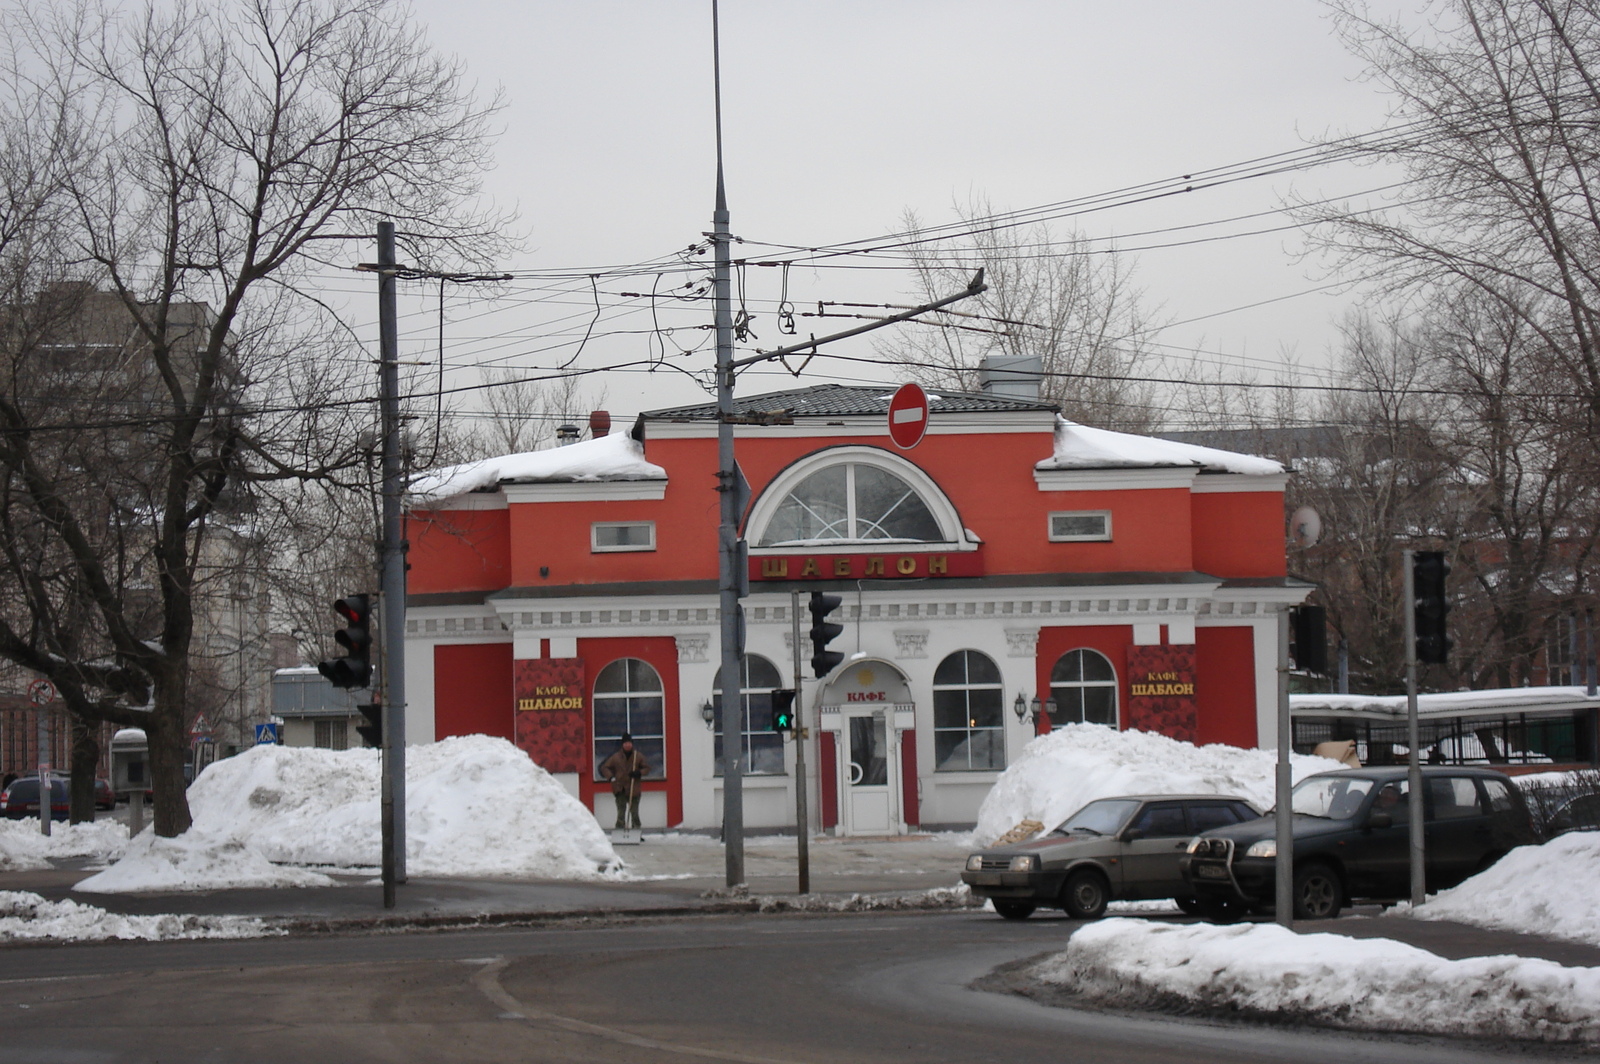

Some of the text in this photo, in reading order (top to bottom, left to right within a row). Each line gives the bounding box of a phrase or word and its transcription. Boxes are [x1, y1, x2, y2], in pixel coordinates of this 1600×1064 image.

[761, 556, 948, 577] ШАБЛОН
[1148, 672, 1178, 681] КАФЕ
[536, 686, 567, 695] КАФЕ
[1131, 684, 1194, 696] ШАБЛОН
[847, 692, 886, 702] КАФЕ
[519, 697, 583, 711] ШАБЛОН
